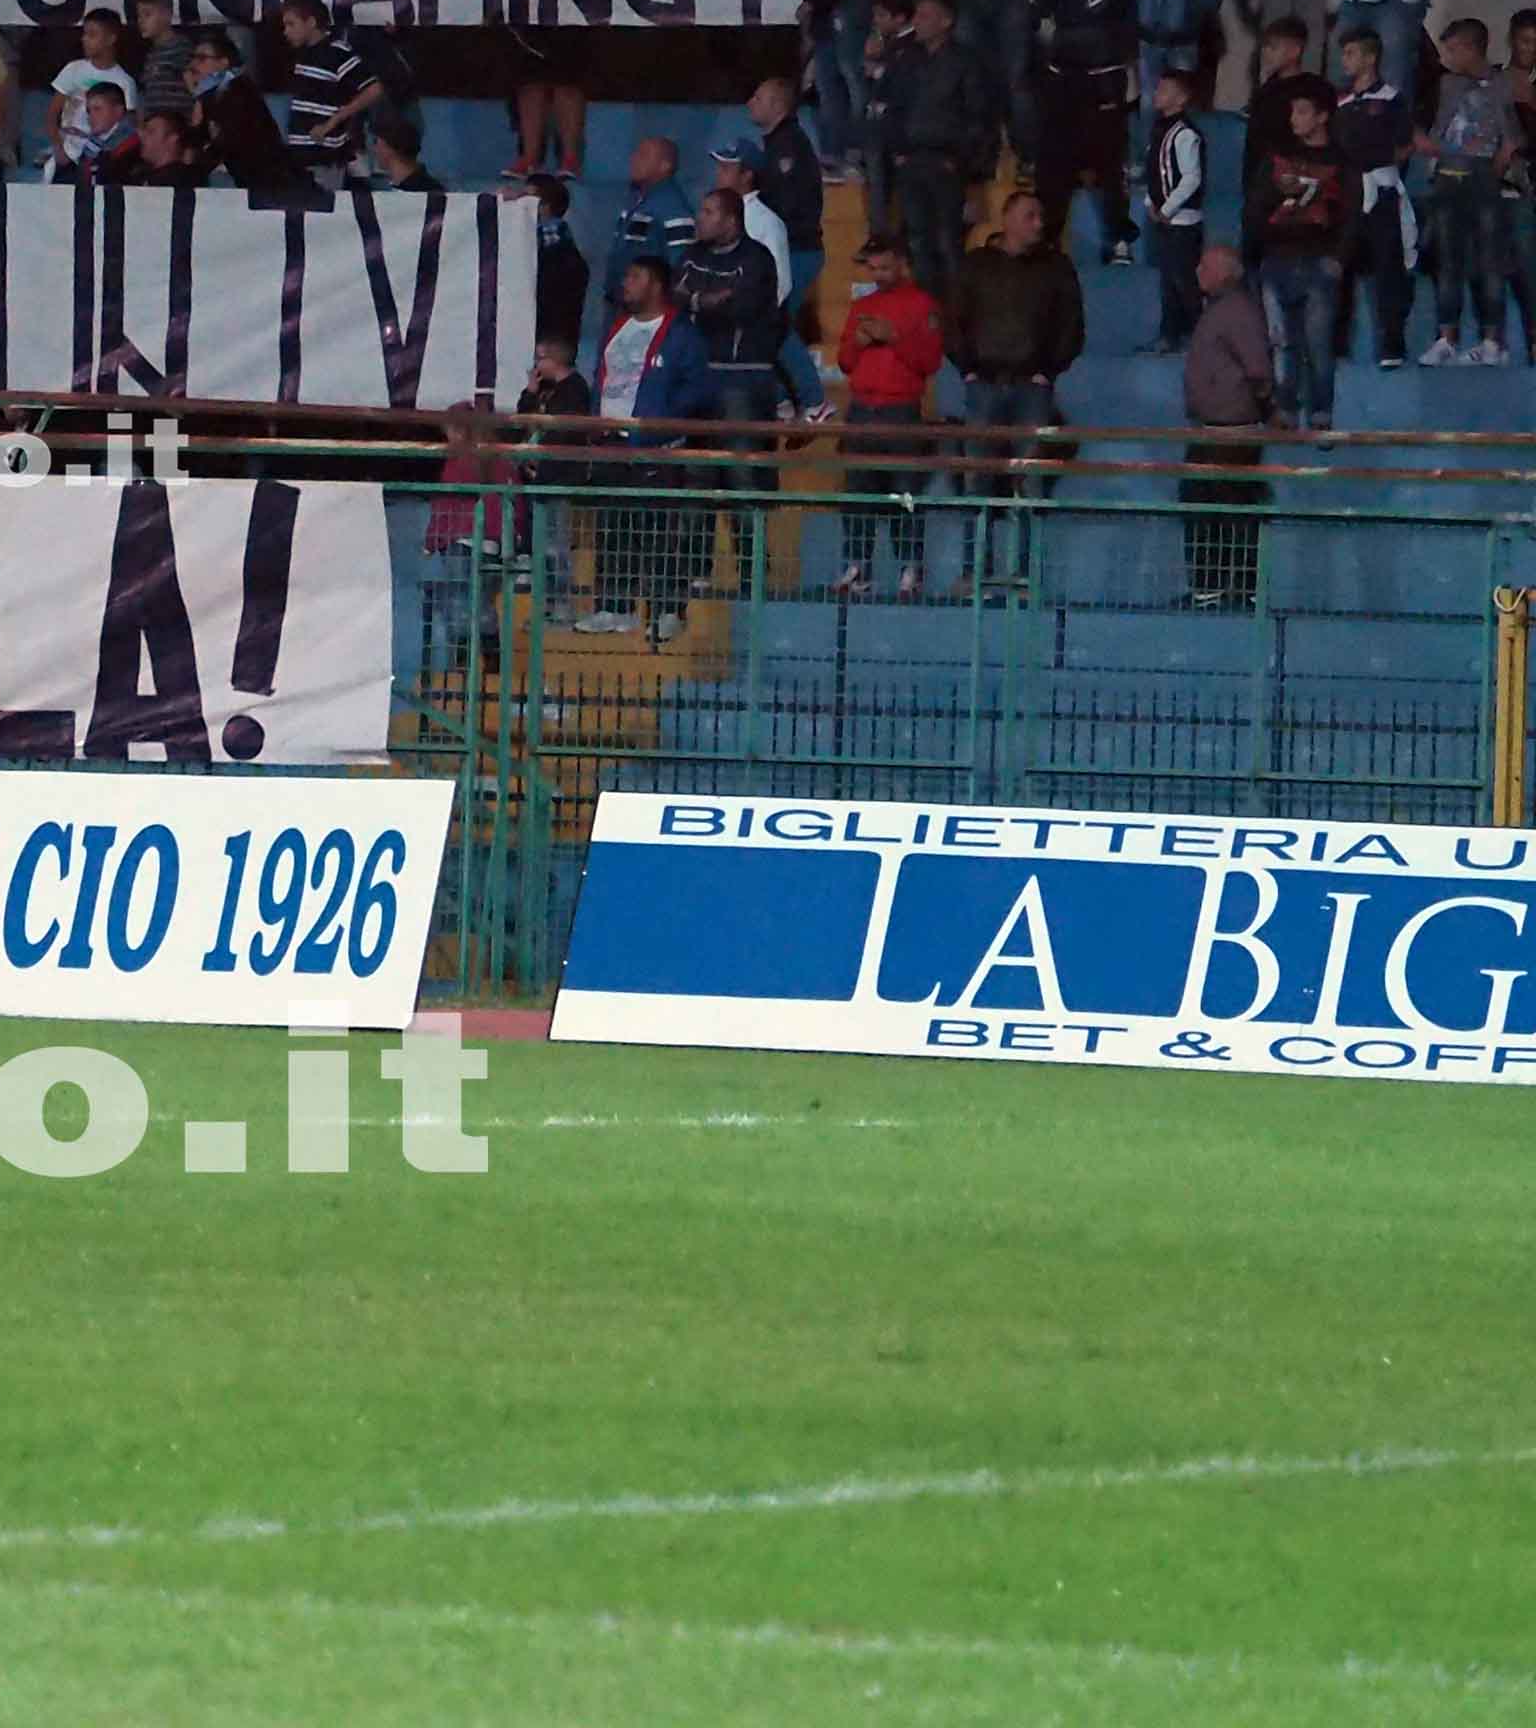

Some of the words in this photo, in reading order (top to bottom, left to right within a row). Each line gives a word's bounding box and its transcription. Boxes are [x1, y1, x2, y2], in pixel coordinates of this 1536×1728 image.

[73, 182, 194, 399] IN
[248, 184, 500, 410] TV!
[202, 827, 407, 978] 1926
[660, 805, 1410, 869] BIGLIETTERIA
[848, 852, 1072, 1014] LA
[1178, 869, 1529, 1035] BIG
[926, 1018, 1128, 1055] BET
[1158, 1030, 1232, 1062] &
